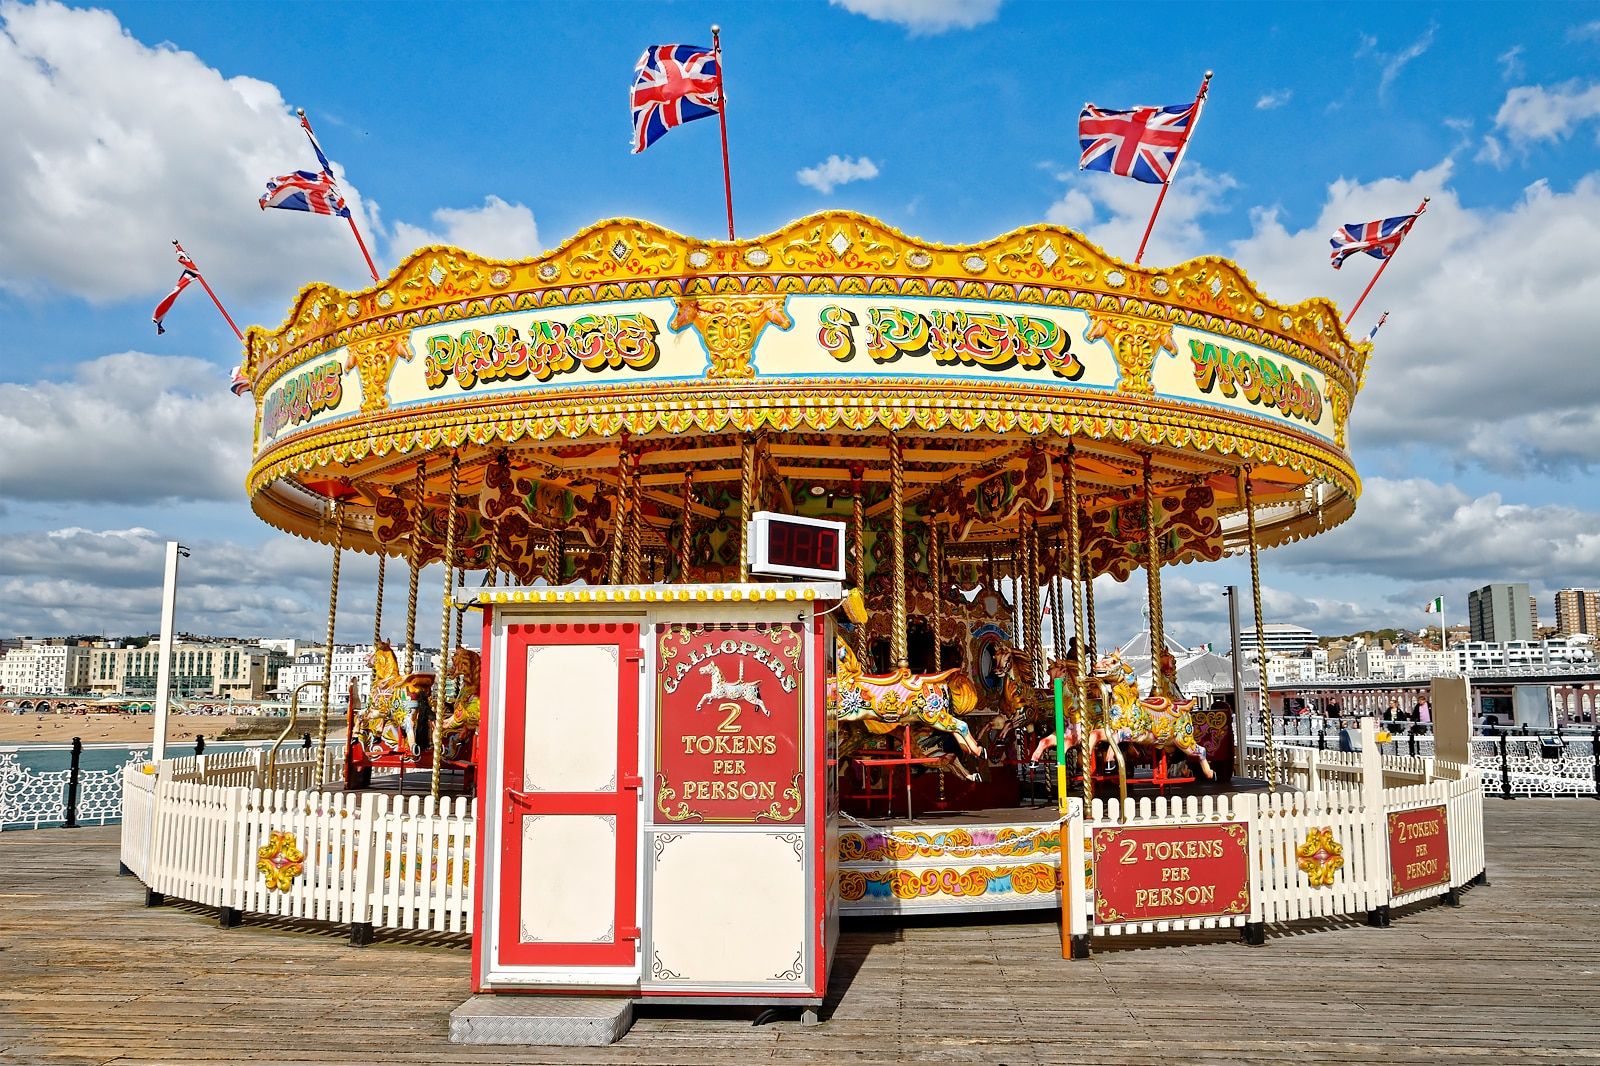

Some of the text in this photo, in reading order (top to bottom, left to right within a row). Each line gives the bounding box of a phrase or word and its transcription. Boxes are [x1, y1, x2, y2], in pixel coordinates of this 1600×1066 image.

[424, 311, 660, 391] PALACE
[865, 305, 1086, 382] PIER
[1188, 338, 1323, 426] WORLD
[663, 639, 798, 694] GALLOPERS
[717, 702, 743, 734] 2
[681, 735, 777, 755] TOKENS
[712, 759, 747, 776] PER
[682, 781, 777, 801] PERSON
[1398, 819, 1440, 844] 2 TOKENS
[1119, 838, 1224, 865] 2 TOKENS
[1415, 843, 1428, 857] PER
[1161, 866, 1191, 882] PER
[1406, 858, 1438, 880] PERSON
[1135, 884, 1216, 908] PERSON
